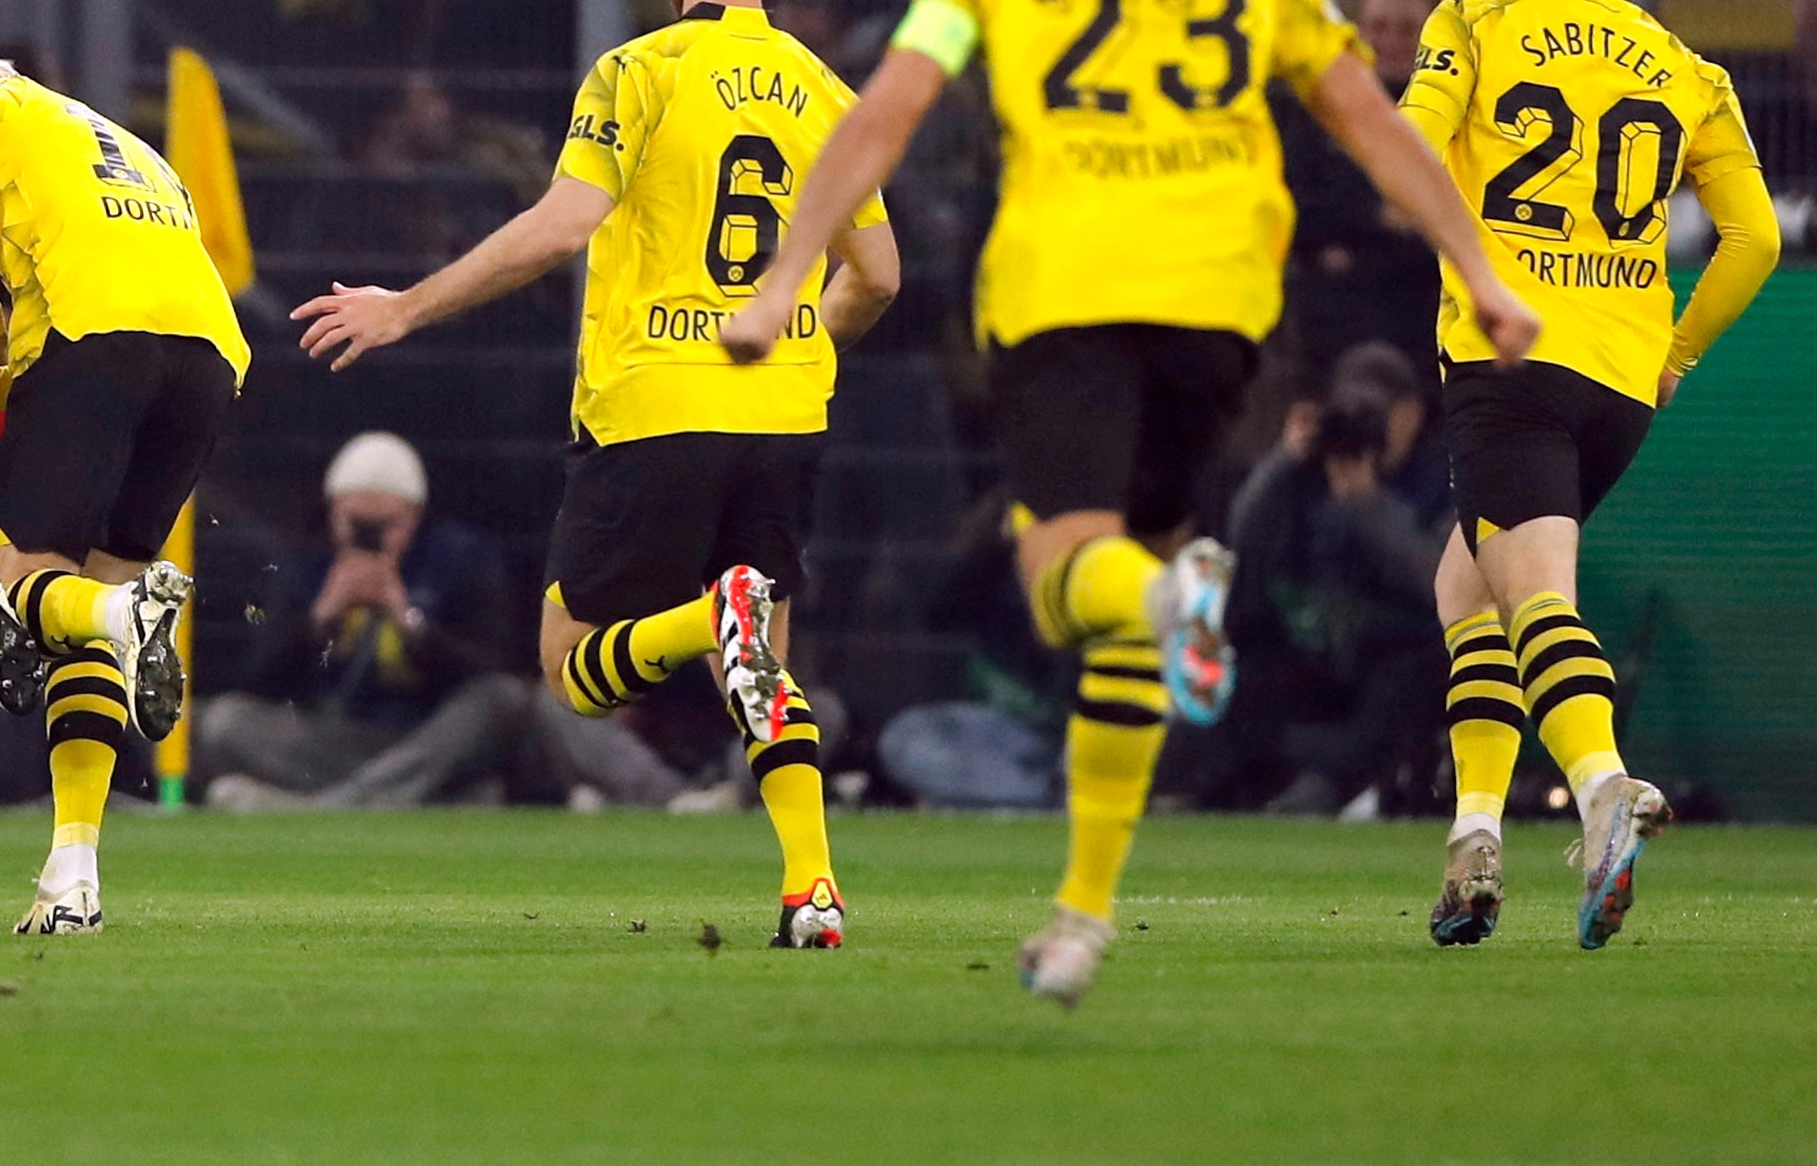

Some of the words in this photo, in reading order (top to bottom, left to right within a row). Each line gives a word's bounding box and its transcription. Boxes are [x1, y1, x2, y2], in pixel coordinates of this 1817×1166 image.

[1520, 22, 1673, 89] SABITZER
[710, 65, 809, 118] ÖZCAN
[1481, 80, 1688, 250] 20
[704, 133, 794, 298] 6
[1516, 248, 1658, 289] ORTMUND
[647, 303, 817, 342] DORTND
